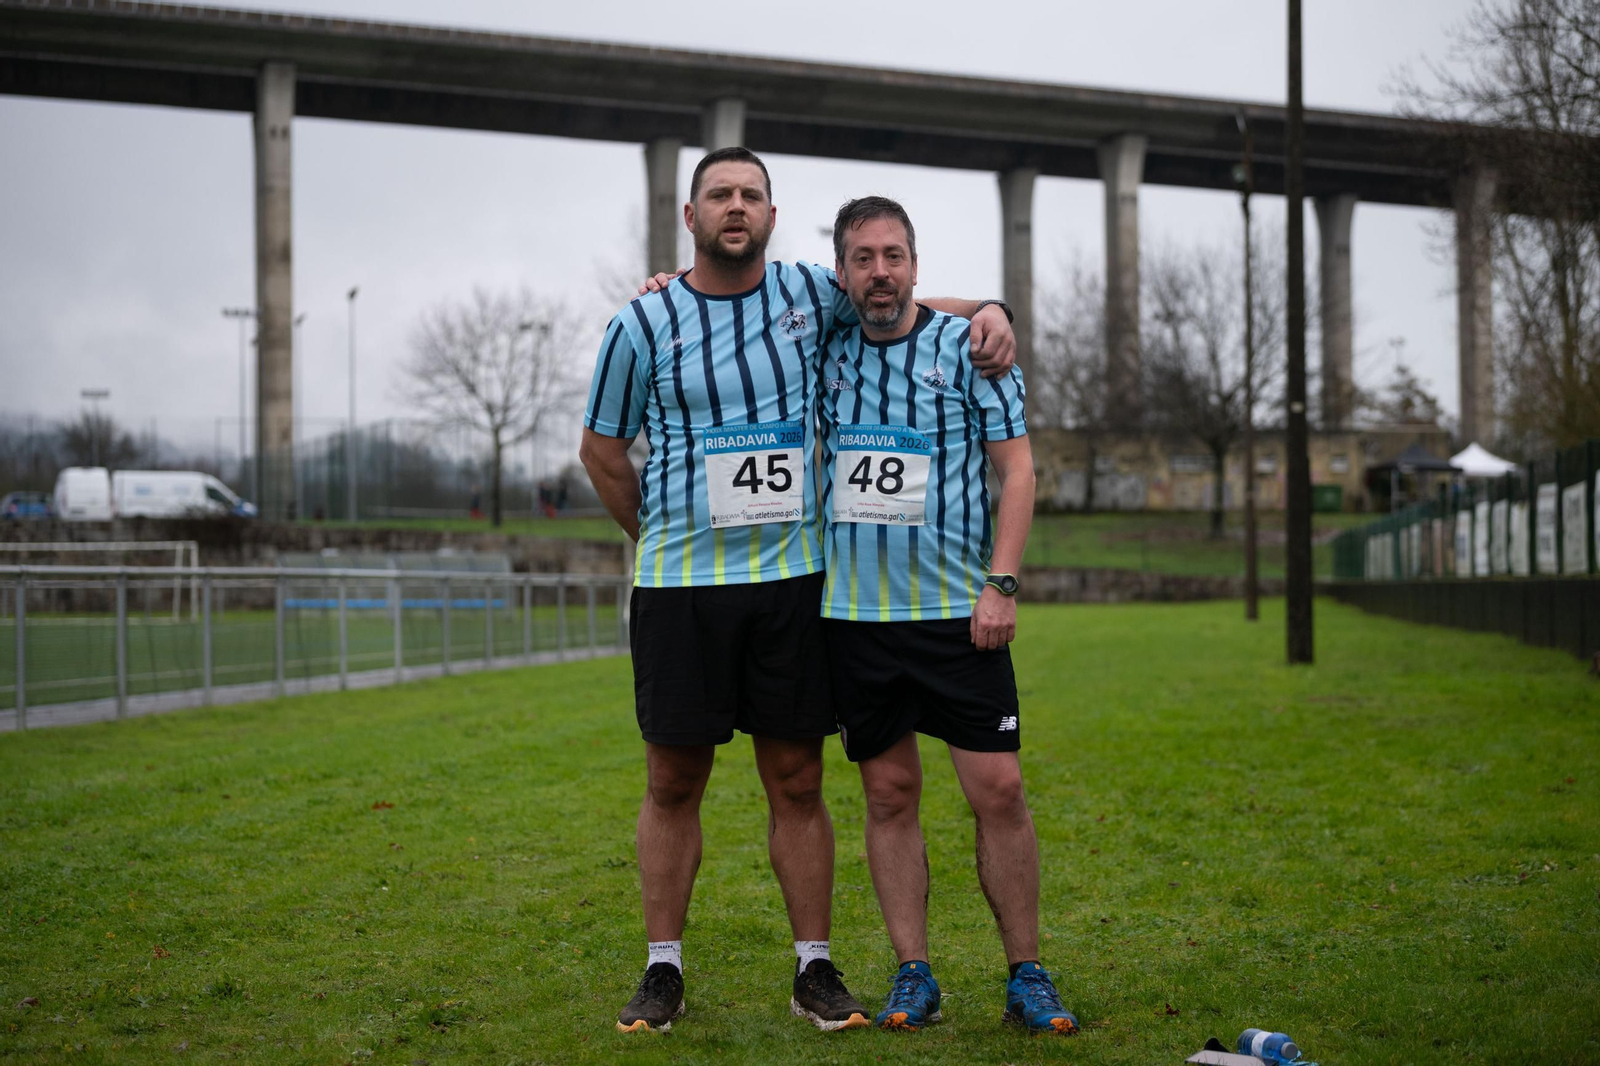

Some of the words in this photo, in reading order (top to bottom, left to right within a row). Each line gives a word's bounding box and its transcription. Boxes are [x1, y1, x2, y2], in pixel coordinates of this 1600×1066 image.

[723, 425, 748, 433] MASTER
[758, 422, 779, 430] CAMPO
[880, 425, 902, 433] CAMPO
[705, 432, 778, 450] RIBADAVIA
[780, 431, 802, 444] 2026
[838, 434, 897, 448] RIBADAVIA
[899, 436, 930, 450] 2026
[732, 453, 792, 494] 45
[847, 455, 905, 495] 48
[755, 509, 794, 519] atletismo.gal
[858, 510, 900, 522] atletismo.gal
